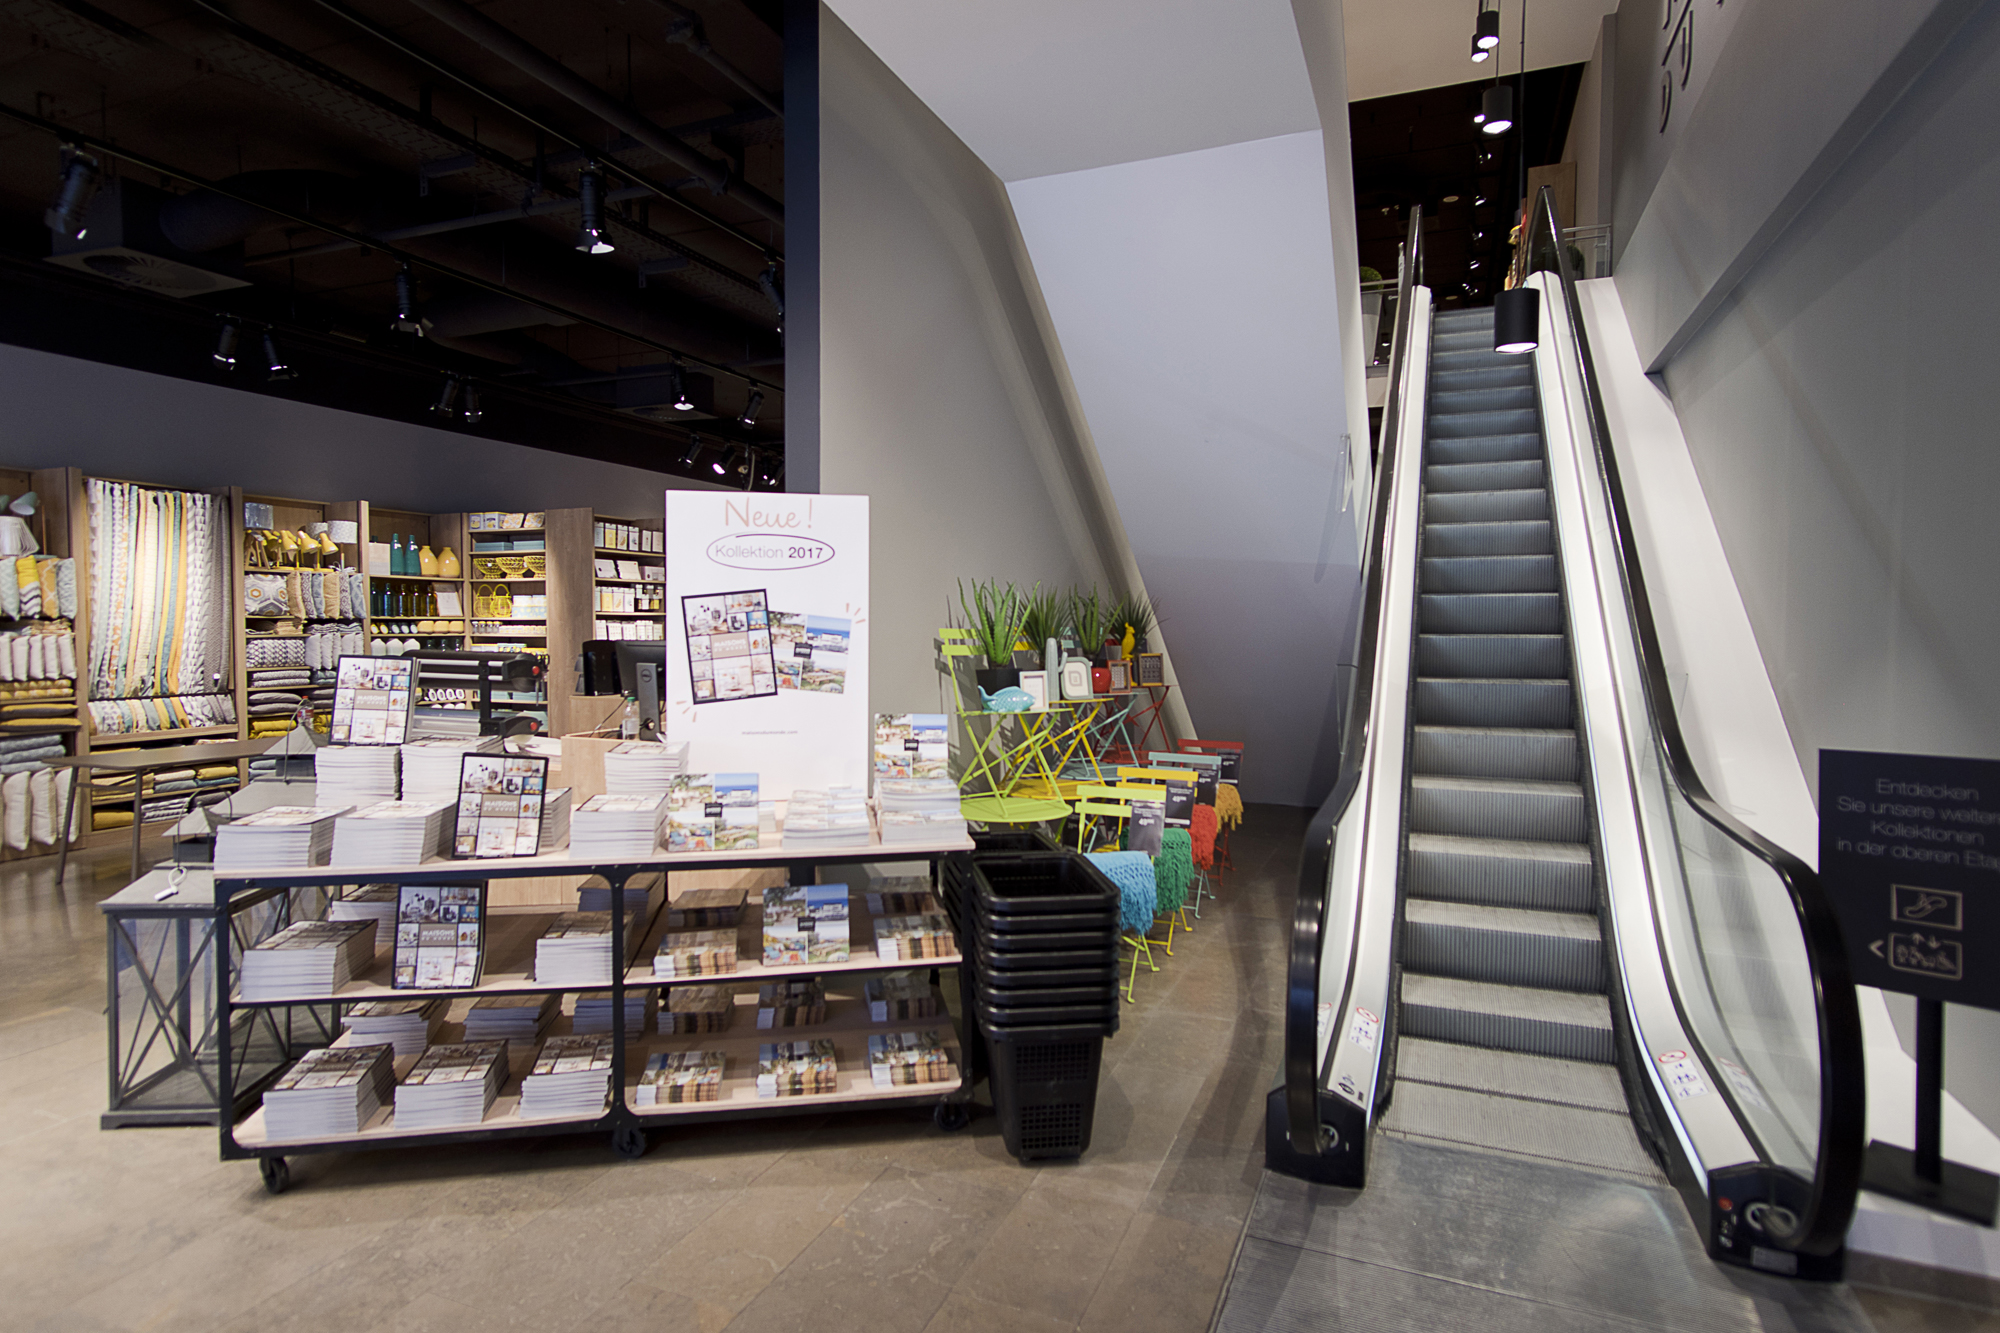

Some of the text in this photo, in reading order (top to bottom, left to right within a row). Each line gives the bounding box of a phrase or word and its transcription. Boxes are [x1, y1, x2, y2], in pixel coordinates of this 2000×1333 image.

[715, 544, 823, 559] Kollektion 2017
[1876, 778, 1979, 801] Entdecken
[1837, 796, 1866, 813] Sie
[1870, 803, 1935, 820] unsere
[1871, 820, 1984, 846] Kollektionen
[1836, 837, 1852, 852] in
[1855, 841, 1886, 856] der
[1890, 845, 1959, 865] oberen
